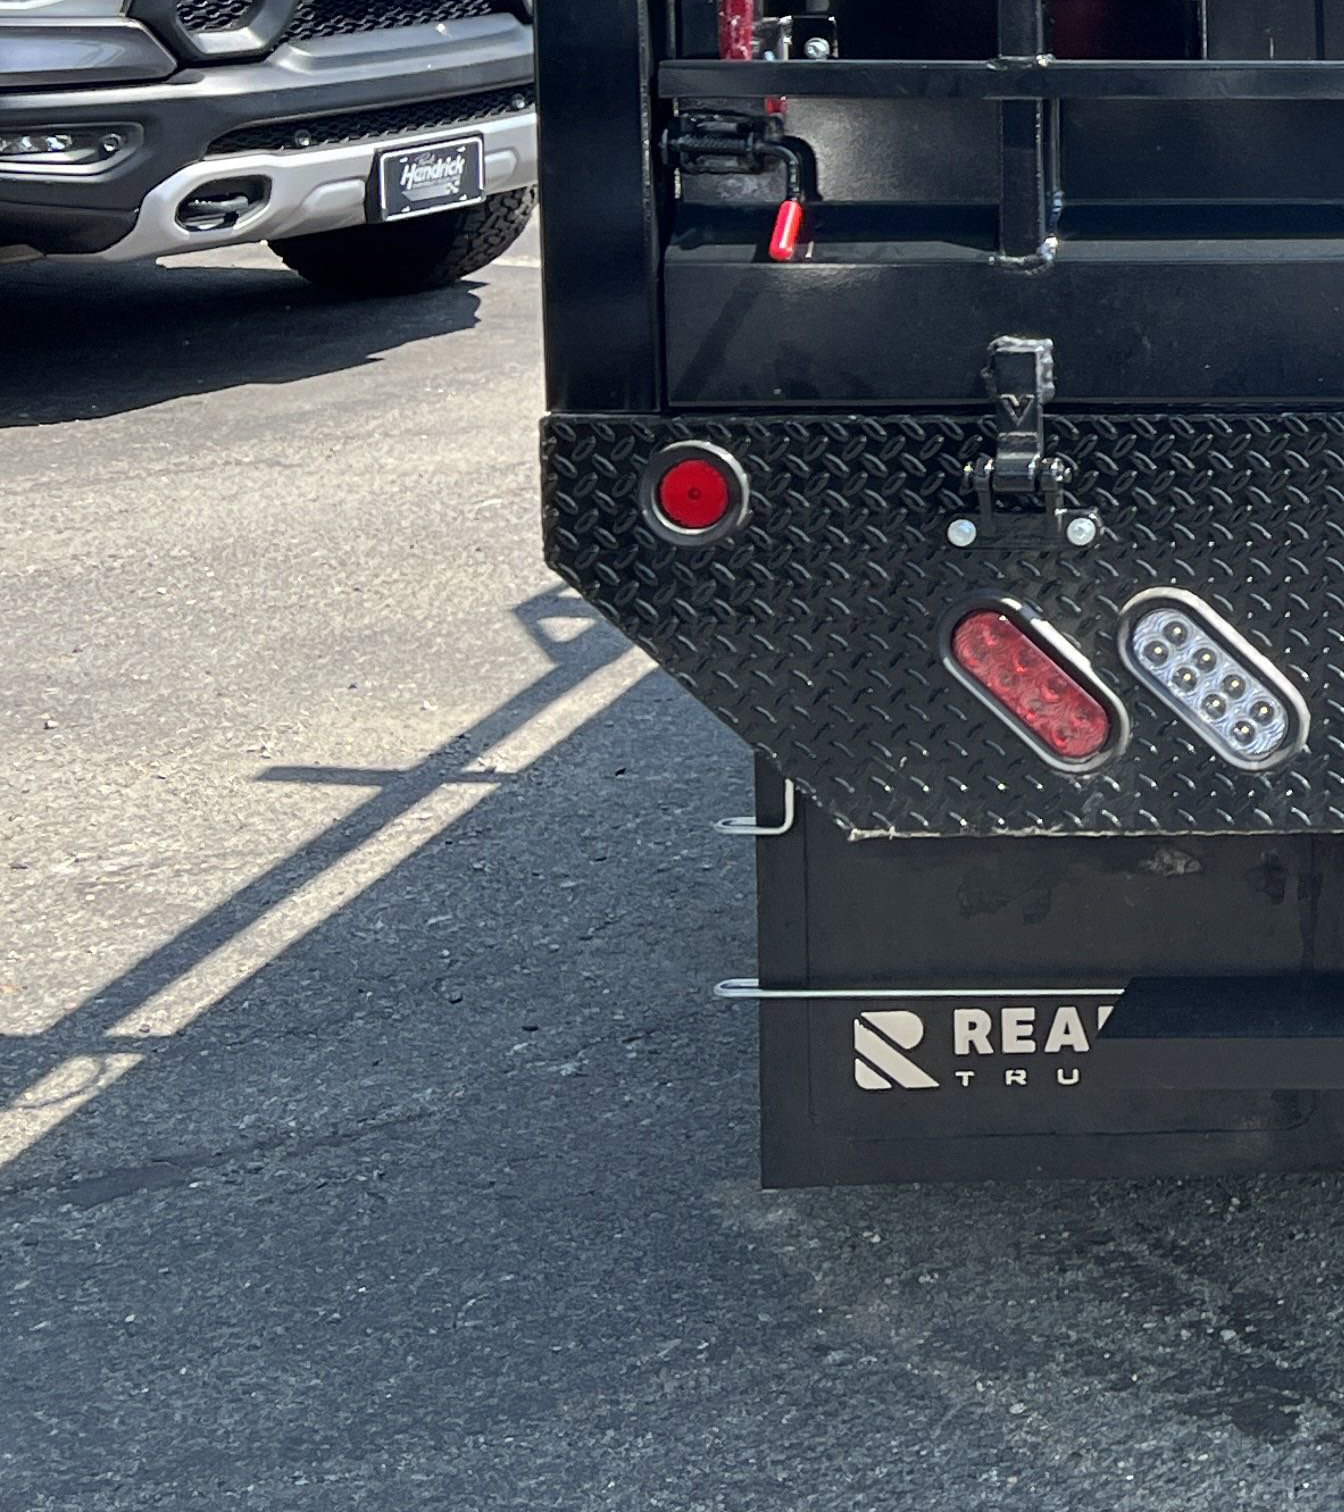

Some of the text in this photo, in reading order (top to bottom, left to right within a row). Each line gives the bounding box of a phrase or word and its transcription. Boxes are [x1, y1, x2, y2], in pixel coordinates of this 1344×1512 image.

[400, 155, 466, 190] Hendrick
[953, 1005, 1114, 1055] REA
[954, 1068, 1080, 1087] TRU
